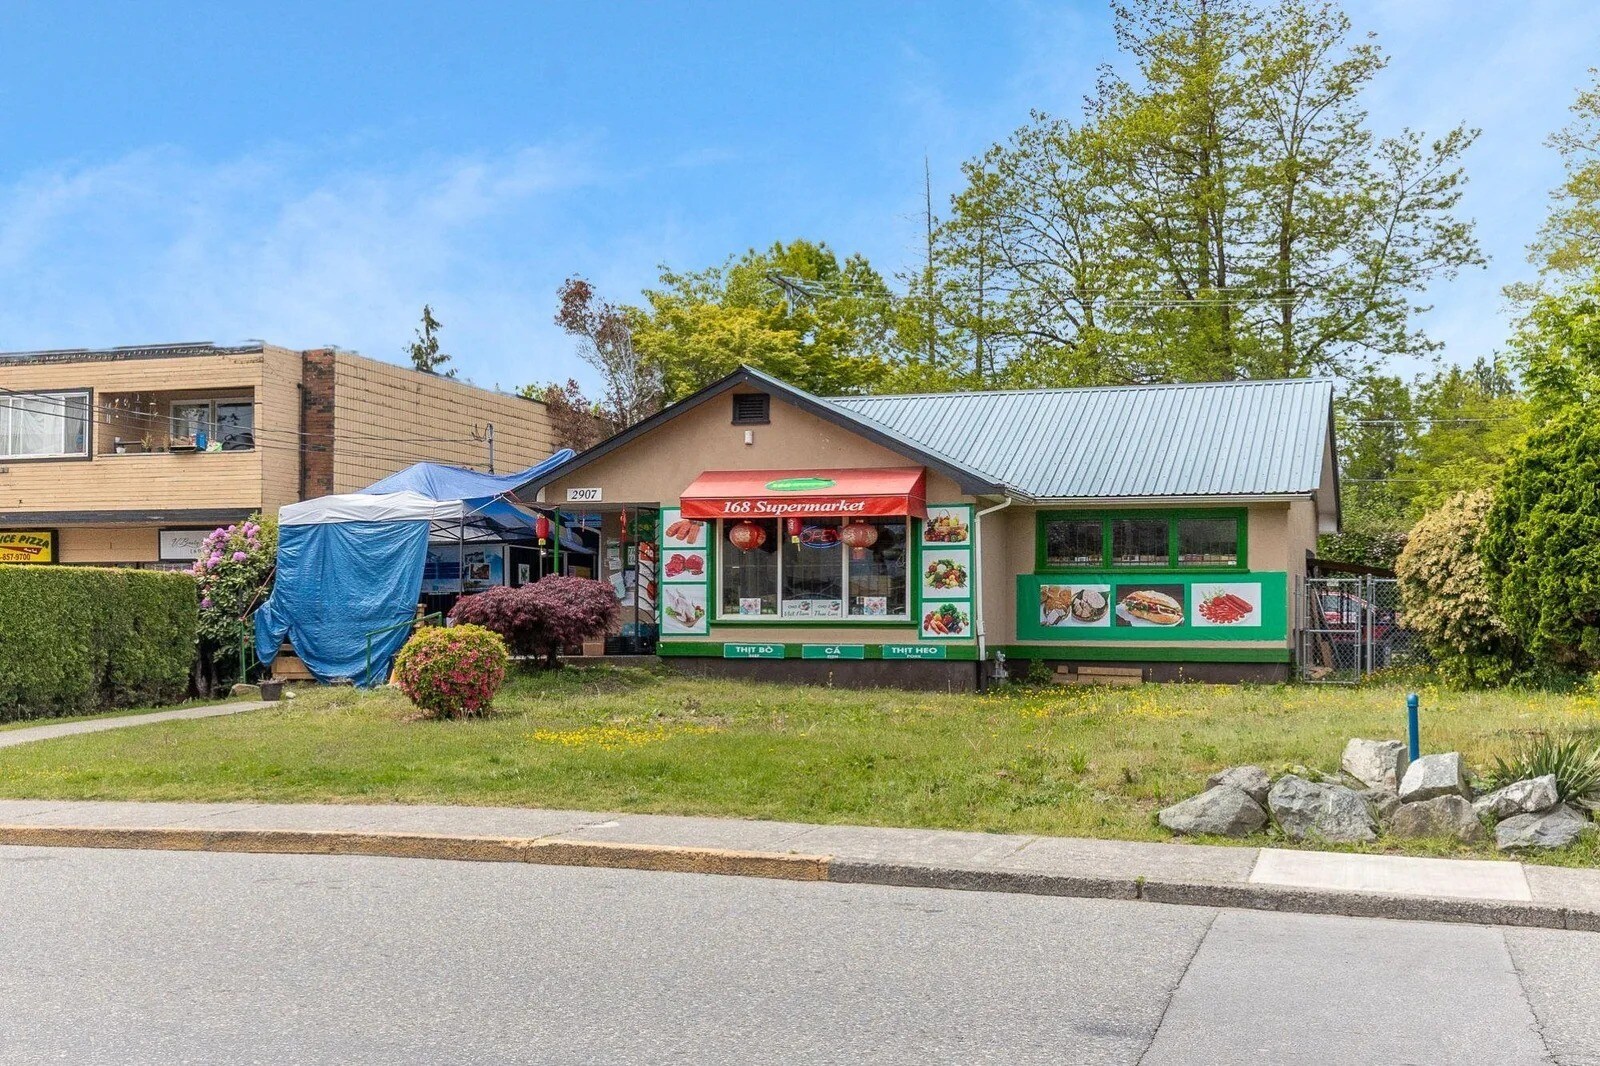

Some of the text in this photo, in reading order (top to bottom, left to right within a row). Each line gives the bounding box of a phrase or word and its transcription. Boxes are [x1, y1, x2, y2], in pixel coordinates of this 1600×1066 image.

[571, 489, 597, 499] 2907
[724, 499, 865, 515] 168 Supermarket
[18, 534, 49, 549] PIZZA
[736, 646, 756, 654] THỊT
[825, 645, 841, 654] CÁ
[892, 647, 912, 655] THỊT
